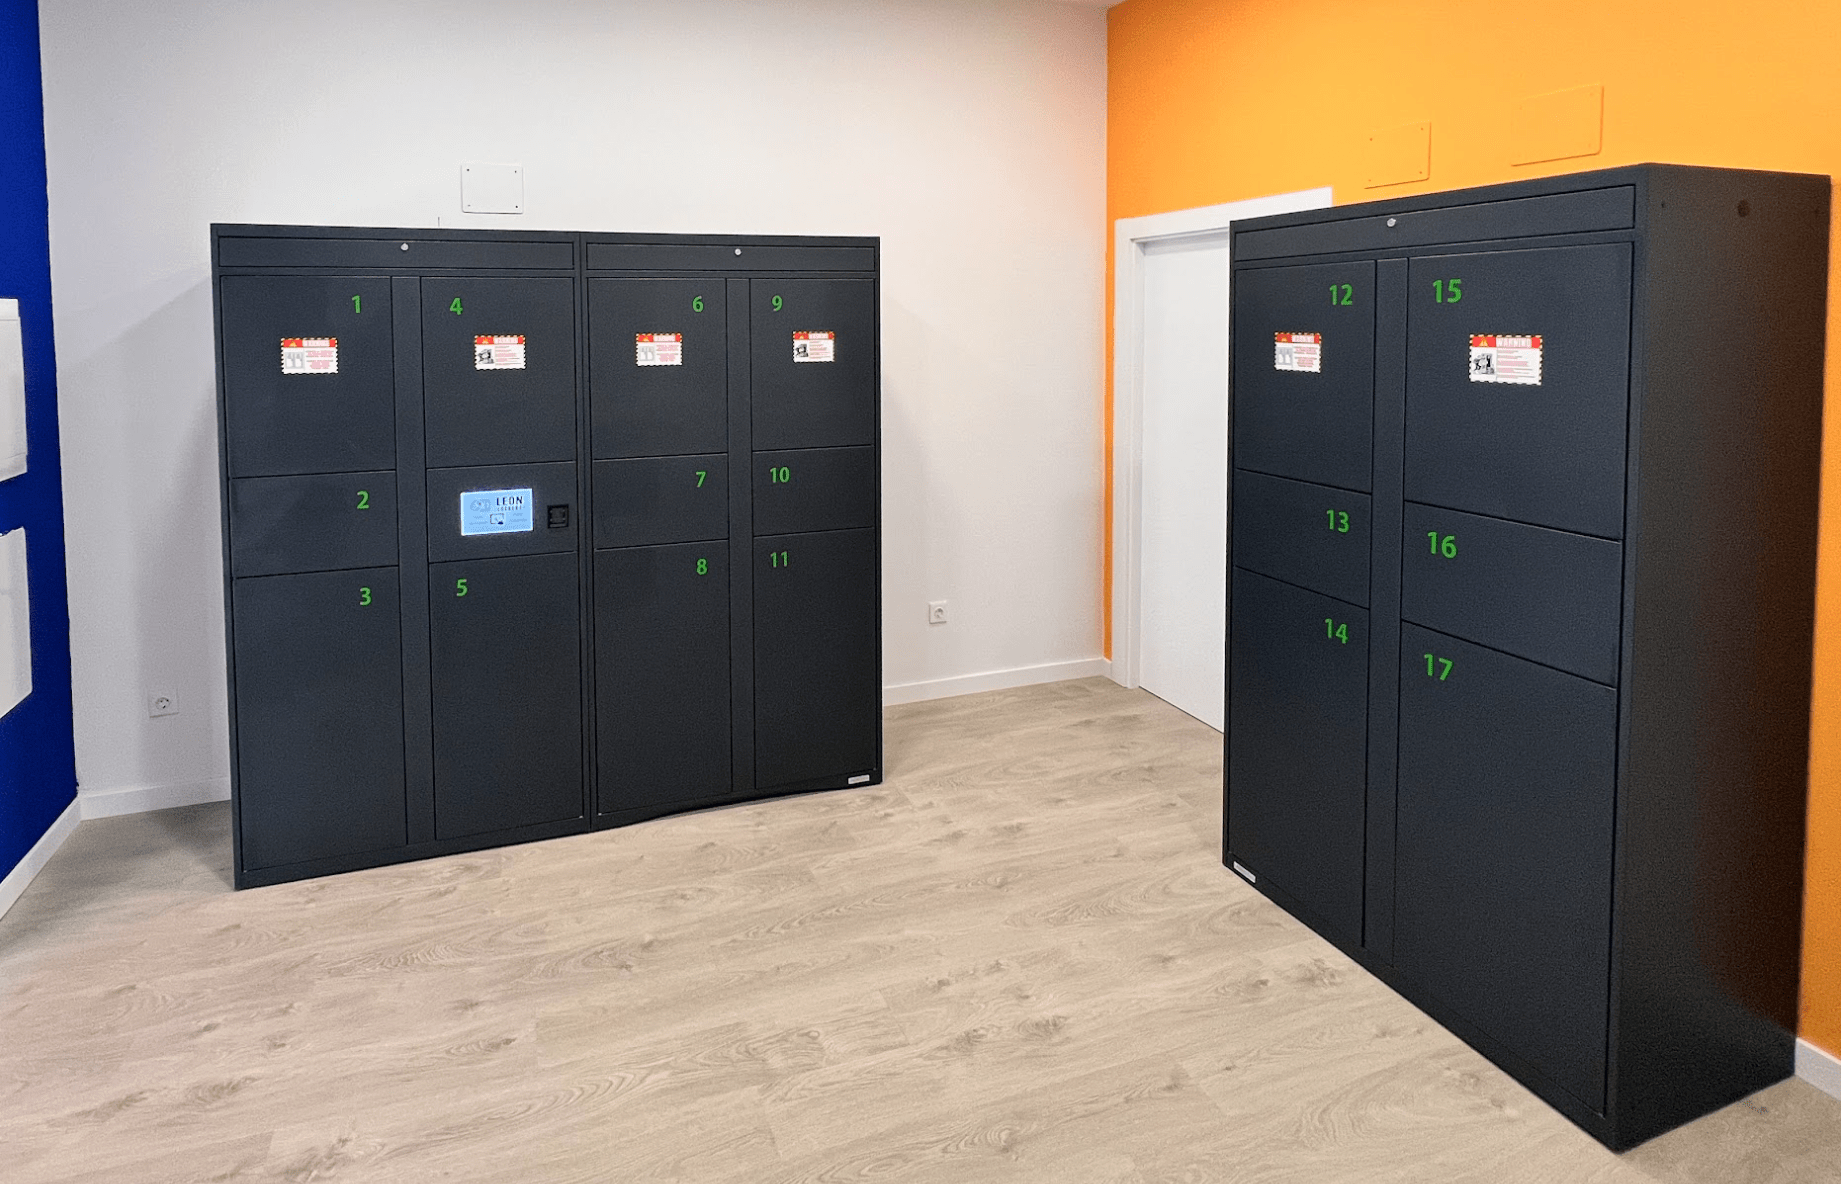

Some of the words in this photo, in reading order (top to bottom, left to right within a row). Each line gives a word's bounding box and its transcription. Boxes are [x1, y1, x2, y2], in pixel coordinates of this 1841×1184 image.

[1329, 283, 1354, 307] 12
[1433, 278, 1463, 304] 15
[352, 295, 362, 314] 1
[449, 297, 464, 316] 4
[692, 295, 704, 313] 6
[771, 294, 783, 312] 9
[695, 470, 708, 488] 7
[769, 466, 791, 484] 10
[356, 490, 370, 510] 2
[1326, 508, 1350, 534] 13
[1427, 530, 1458, 559] 16
[695, 557, 708, 575] 8
[770, 551, 789, 568] 11
[360, 586, 372, 607] 3
[456, 577, 469, 597] 5
[1325, 618, 1349, 645] 14
[1423, 652, 1455, 682] 17
